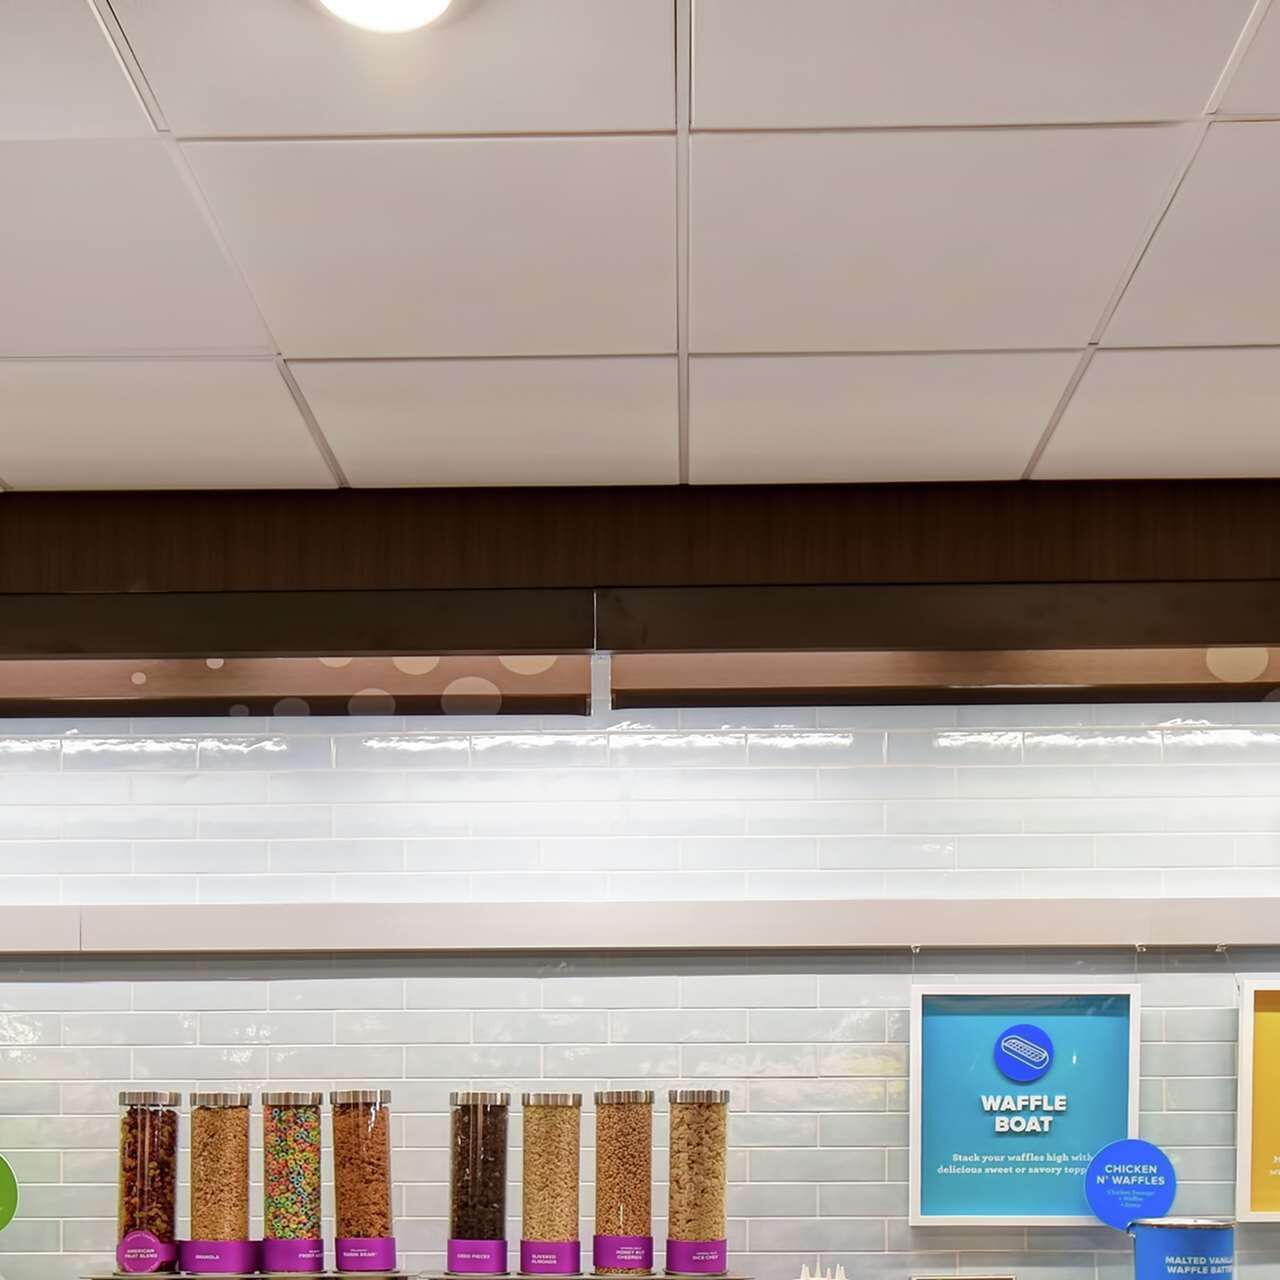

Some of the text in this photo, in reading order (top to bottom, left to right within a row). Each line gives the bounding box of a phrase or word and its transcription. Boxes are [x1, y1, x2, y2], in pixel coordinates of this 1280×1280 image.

[981, 1095, 1067, 1111] WAFFLE
[995, 1116, 1053, 1132] BOAT
[952, 1153, 980, 1162] Stack
[982, 1155, 1005, 1165] your
[1007, 1153, 1045, 1162] waffles
[1047, 1153, 1069, 1164] high
[937, 1165, 982, 1174] delicious
[984, 1166, 1013, 1174] sweet
[1028, 1167, 1062, 1176] savory
[1105, 1164, 1157, 1174] CHICKEN
[1111, 1176, 1165, 1185] WAFFLES
[1165, 1256, 1207, 1265] MALTED
[1167, 1265, 1209, 1274] WAFFLE
